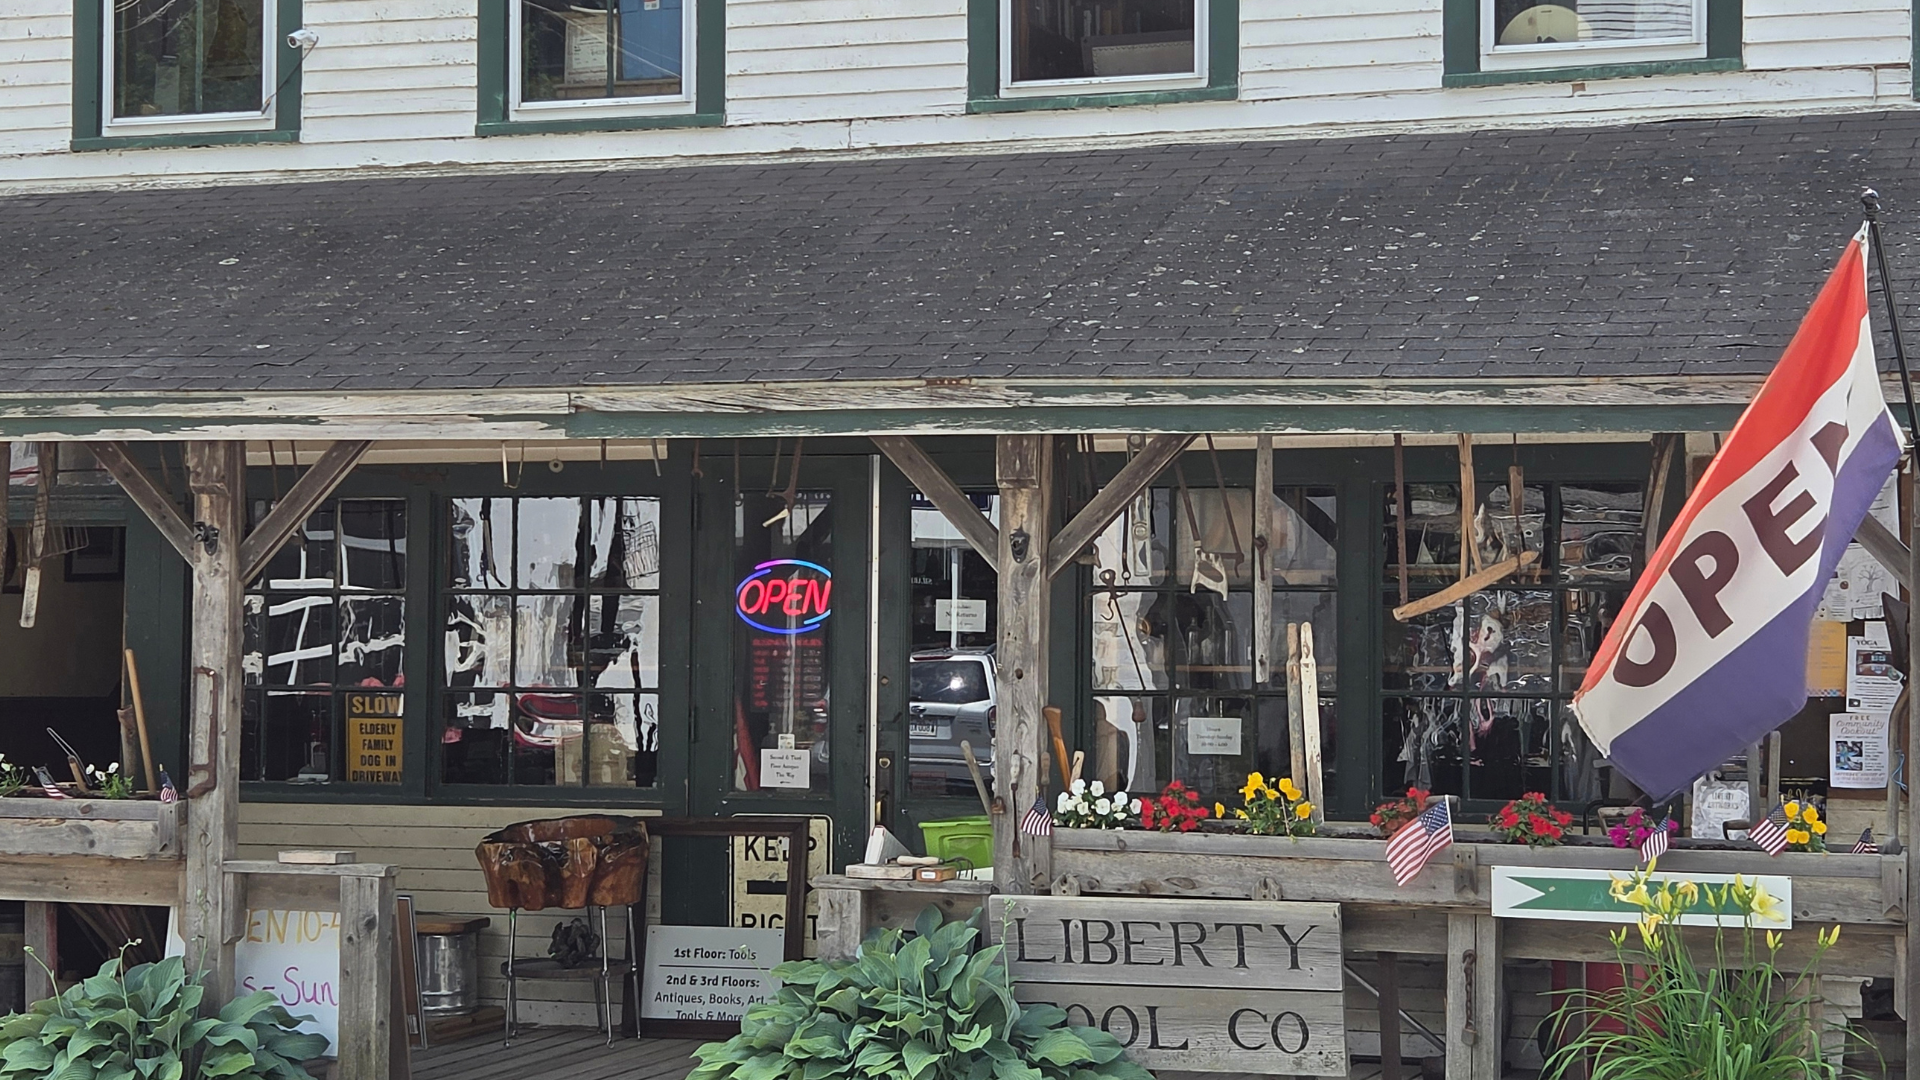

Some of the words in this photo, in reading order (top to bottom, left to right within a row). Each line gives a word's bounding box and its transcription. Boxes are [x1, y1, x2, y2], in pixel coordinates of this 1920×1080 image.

[739, 579, 832, 616] OPEN
[352, 696, 400, 714] SLOW
[359, 723, 397, 735] ELDERLY
[1836, 720, 1885, 730] Community
[362, 739, 394, 751] FAMILY
[360, 755, 381, 767] DOG
[385, 755, 397, 767] IN
[744, 835, 817, 861] KEP
[246, 908, 291, 944] EN
[741, 914, 818, 940] RIGT
[1014, 917, 1319, 970] LIBERTY
[674, 948, 691, 958] 1st
[694, 948, 726, 959] Floor:
[729, 948, 757, 960] Tools
[666, 974, 687, 986] 2nd
[689, 978, 698, 986] &
[700, 975, 719, 987] 3rd
[721, 976, 760, 988] Floors:
[654, 991, 706, 1006] Antiques,
[709, 993, 745, 1007] Books,
[676, 1010, 702, 1020] Tools
[706, 1011, 714, 1020] &
[1018, 1001, 1189, 1051] OL
[1228, 1007, 1310, 1055] CO
